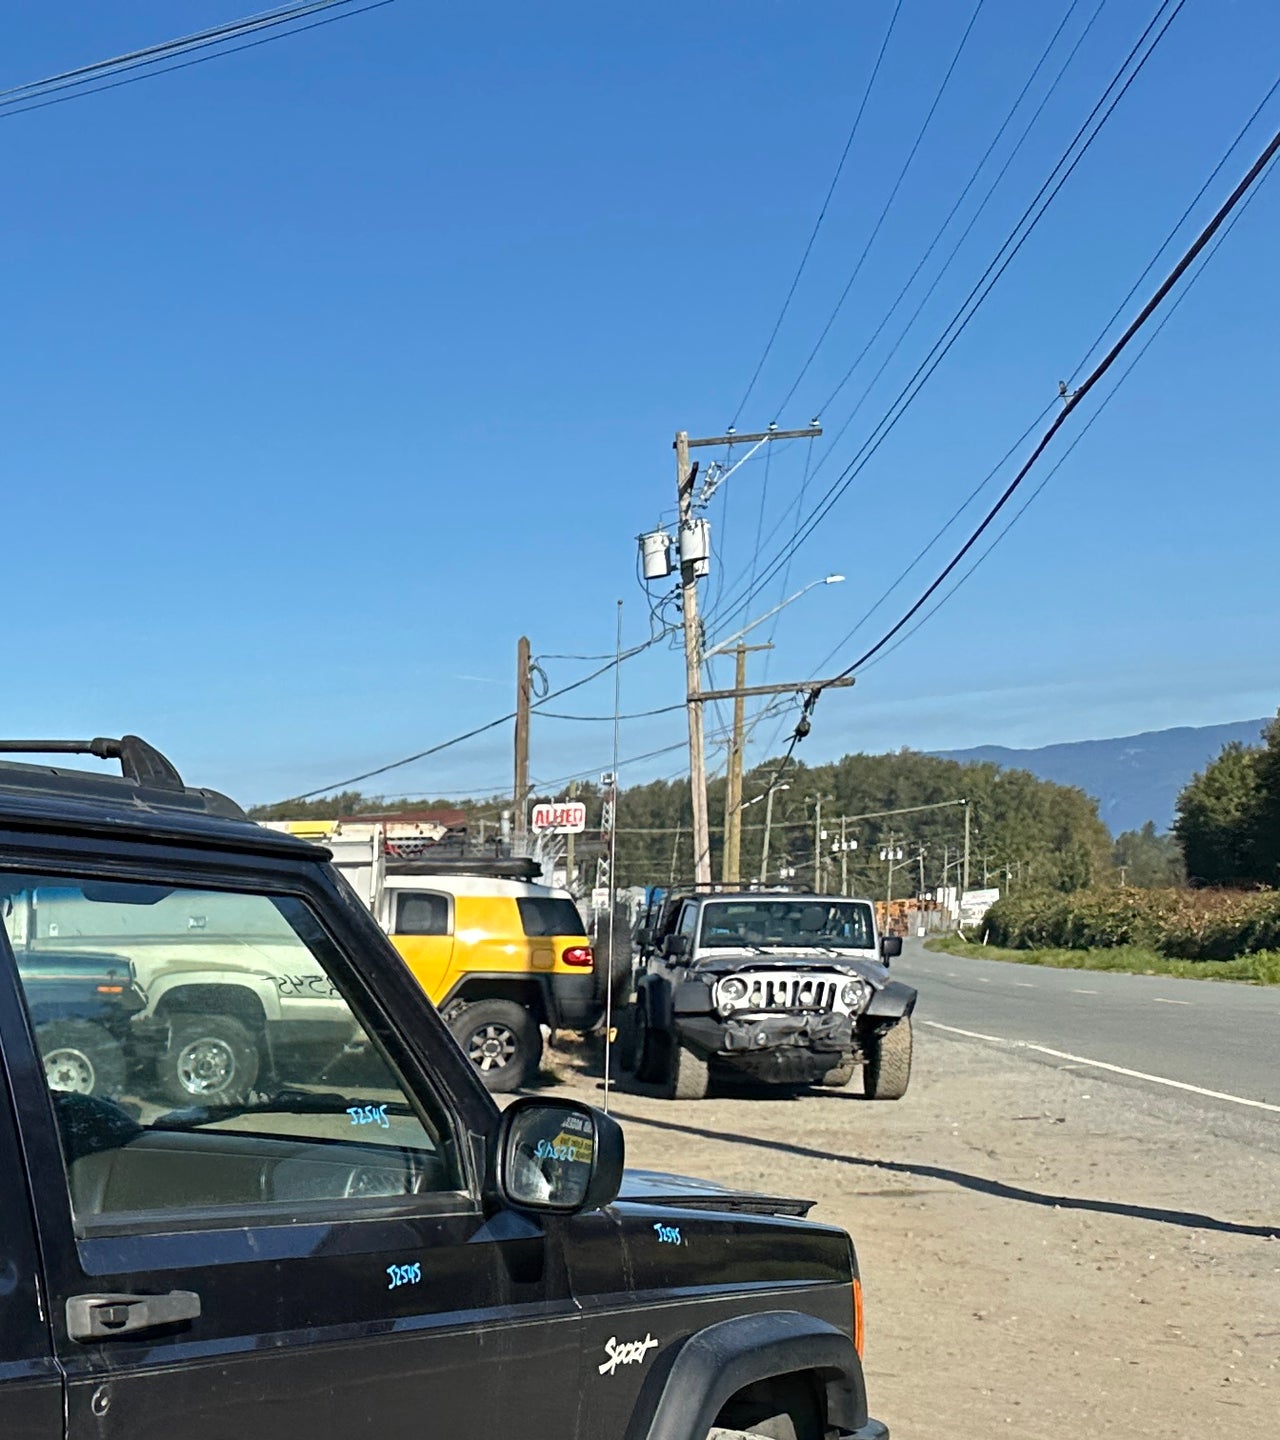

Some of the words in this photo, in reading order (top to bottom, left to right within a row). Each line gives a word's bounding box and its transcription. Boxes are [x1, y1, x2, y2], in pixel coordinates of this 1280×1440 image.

[346, 1104, 390, 1129] J2545
[386, 1262, 422, 1290] J2545
[598, 1332, 659, 1376] Sport
